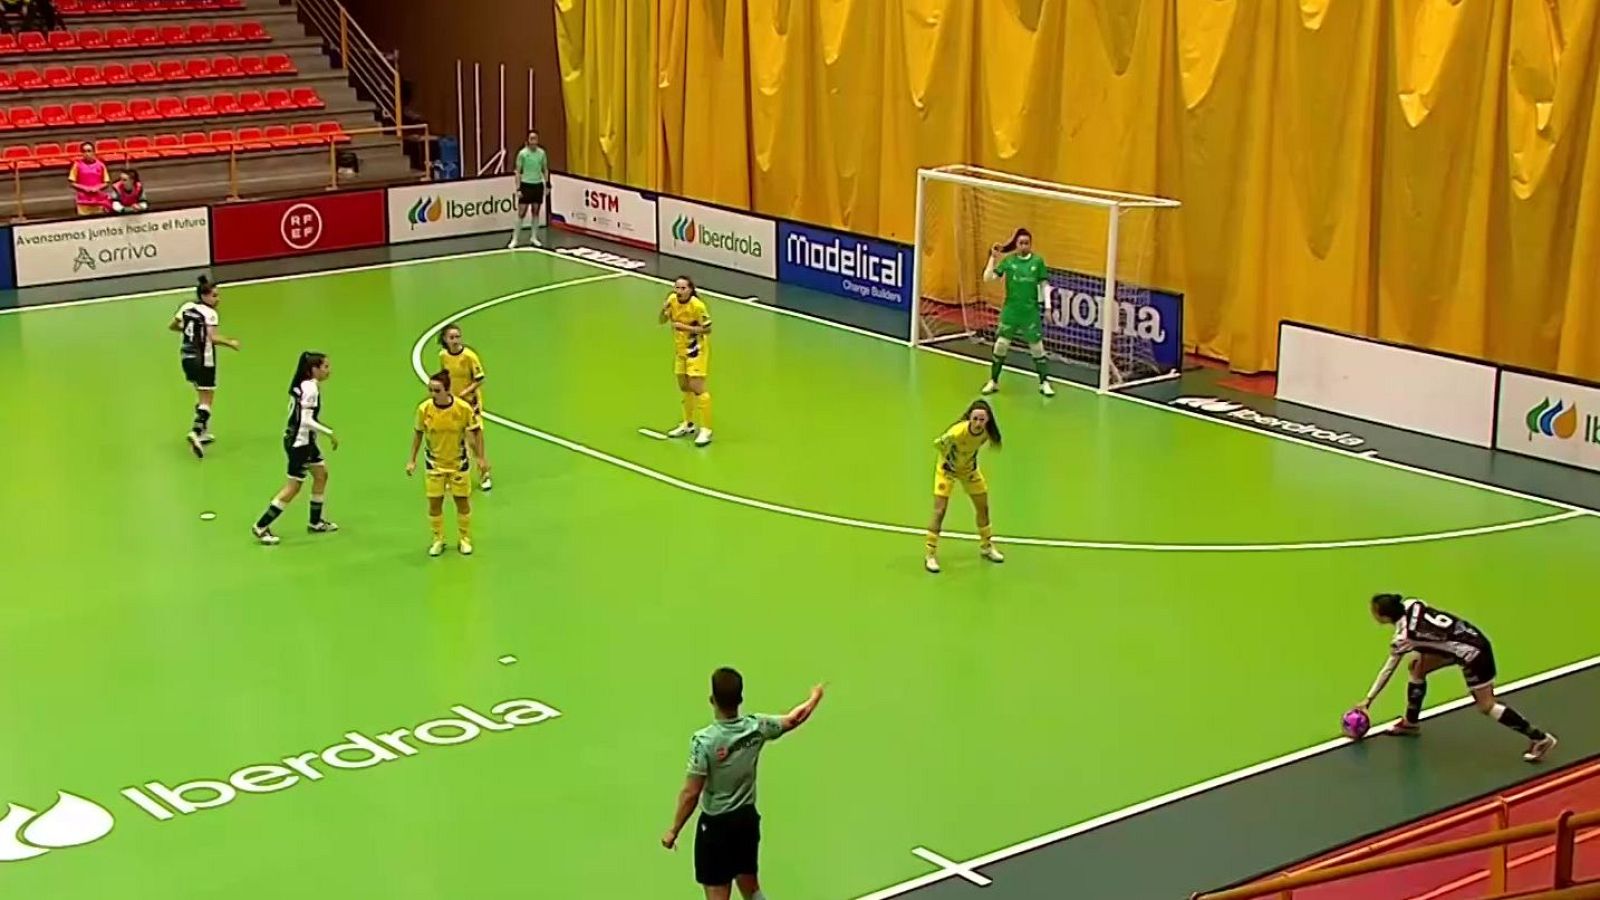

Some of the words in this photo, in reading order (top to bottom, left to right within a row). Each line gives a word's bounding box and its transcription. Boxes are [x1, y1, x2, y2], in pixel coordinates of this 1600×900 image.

[446, 193, 517, 219] Iberdrol
[17, 231, 86, 245] Avanzamos
[88, 227, 123, 240] juntos
[126, 222, 159, 234] hacia
[162, 219, 172, 230] el
[175, 218, 206, 229] futuro
[699, 224, 762, 257] Iberdrola
[99, 243, 157, 263] arriva
[787, 233, 902, 288] Modelical
[842, 279, 870, 297] Change
[871, 286, 901, 303] Builders
[184, 320, 195, 342] 4
[1228, 409, 1365, 446] Iberdrola
[1424, 612, 1453, 629] 6
[120, 698, 562, 821] Iberdrola
